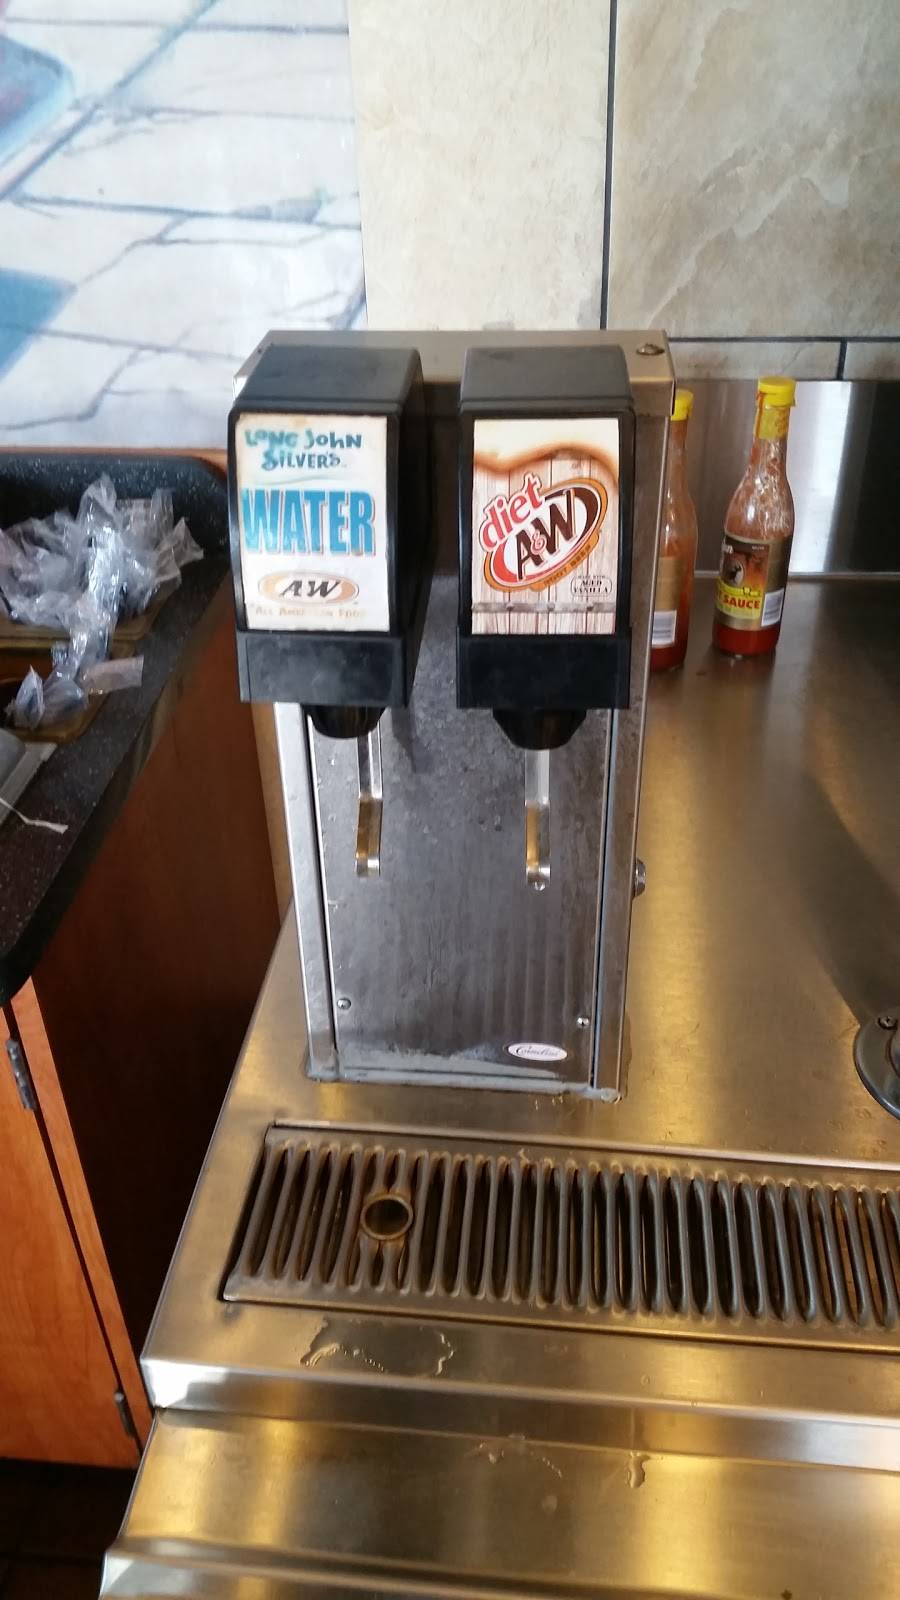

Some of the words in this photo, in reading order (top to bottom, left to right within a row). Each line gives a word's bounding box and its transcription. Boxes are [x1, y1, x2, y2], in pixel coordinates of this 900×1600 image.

[244, 429, 298, 448] LONG
[241, 487, 376, 557] WATER
[481, 474, 543, 549] diet
[516, 489, 579, 583] A&W
[723, 594, 761, 609] SAUCE
